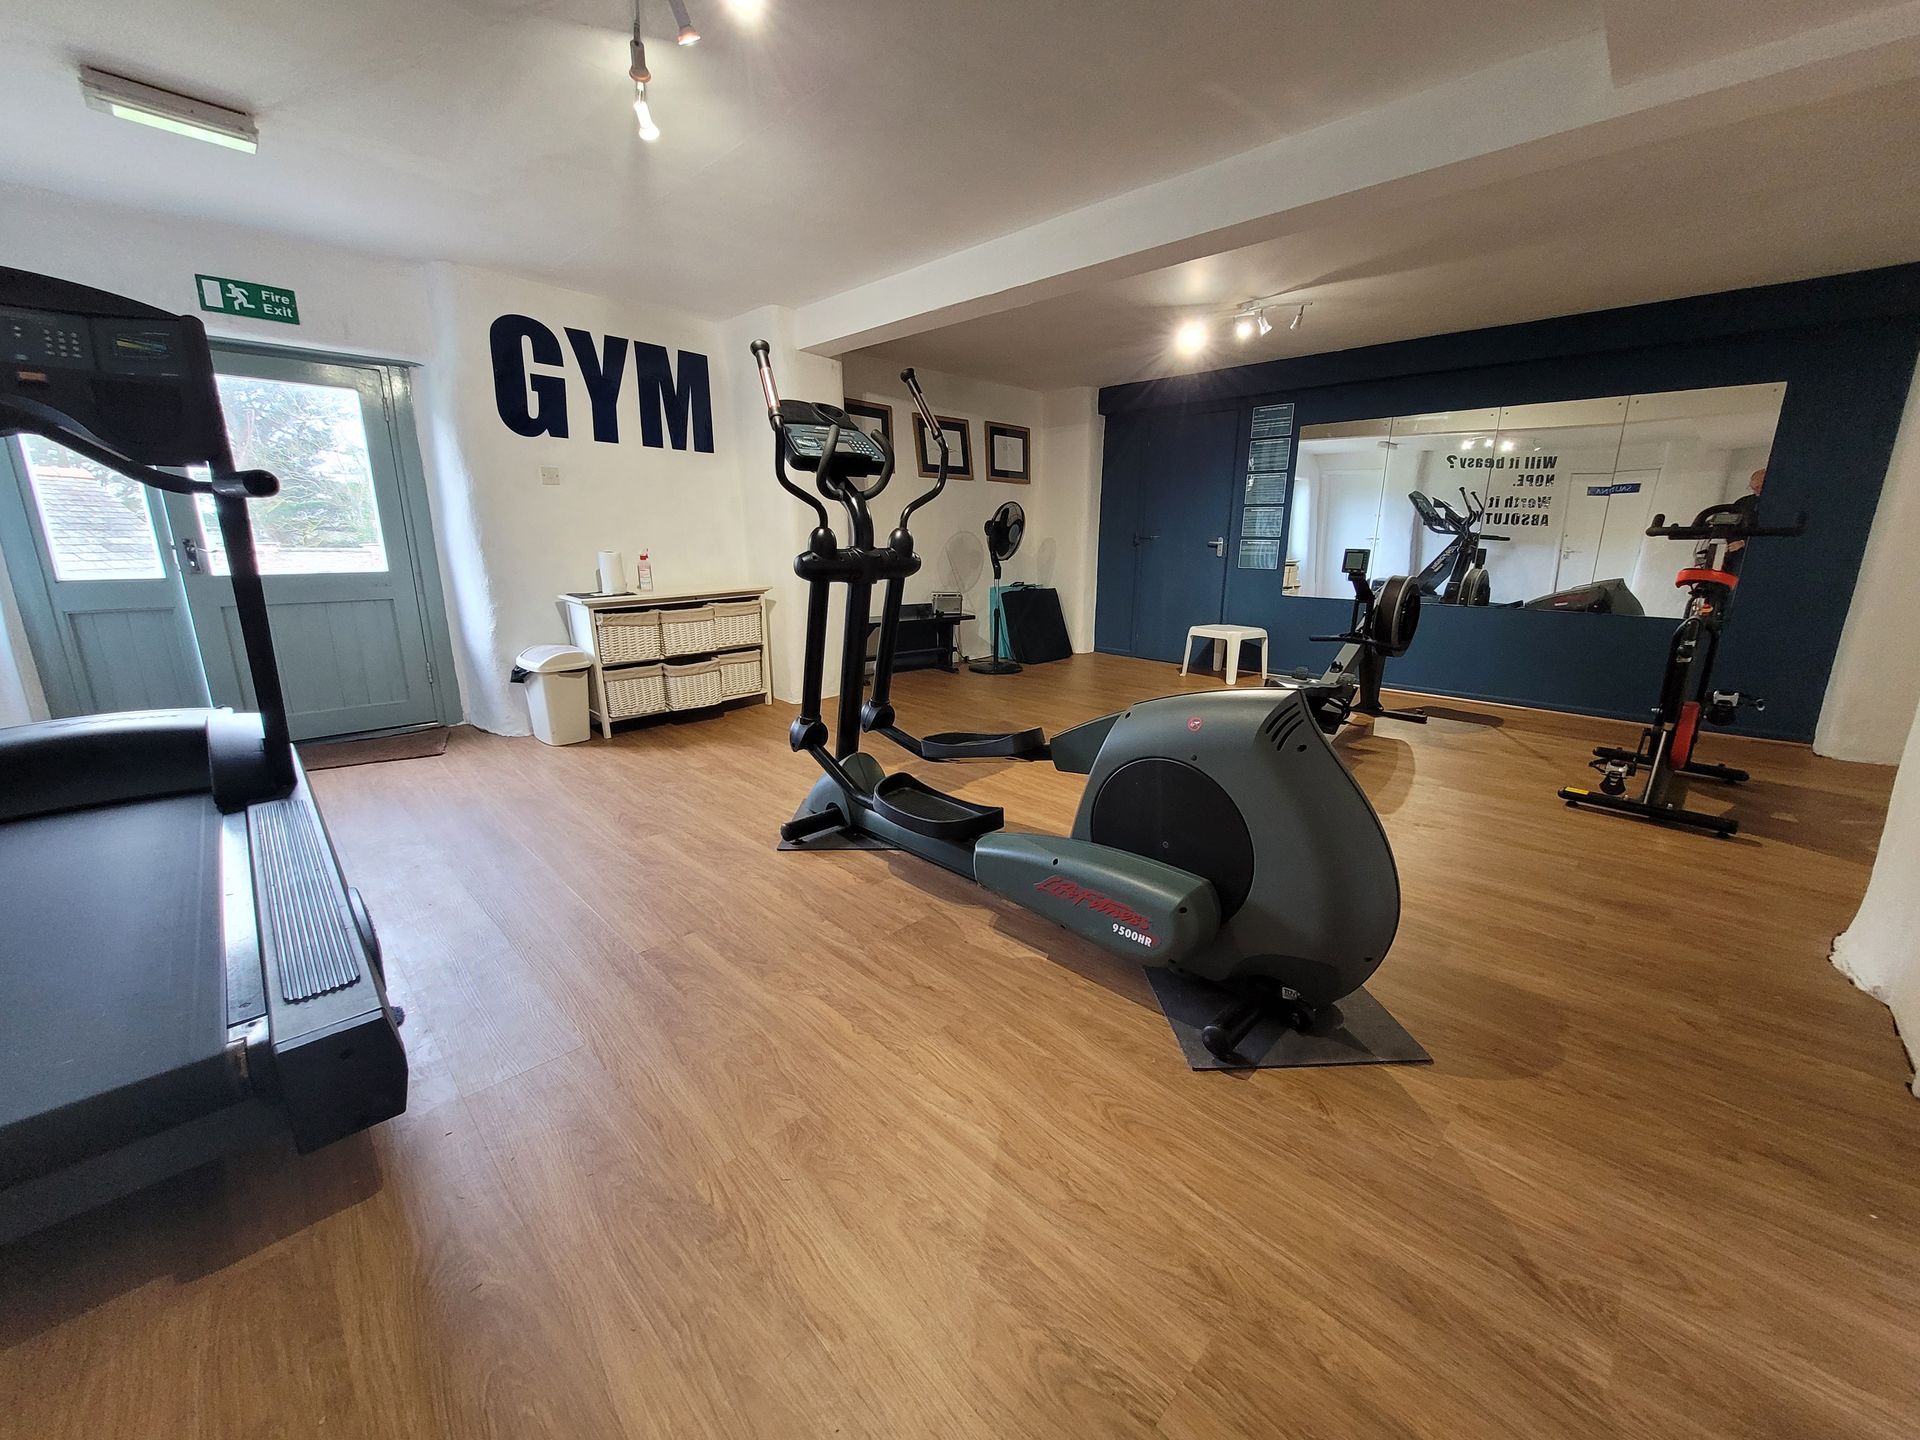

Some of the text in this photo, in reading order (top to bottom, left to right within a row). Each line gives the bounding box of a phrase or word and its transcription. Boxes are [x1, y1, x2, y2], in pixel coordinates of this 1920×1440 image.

[261, 290, 290, 304] Fire
[263, 303, 293, 318] Exit
[489, 314, 715, 454] GYM
[1112, 923, 1152, 947] 9500HR
